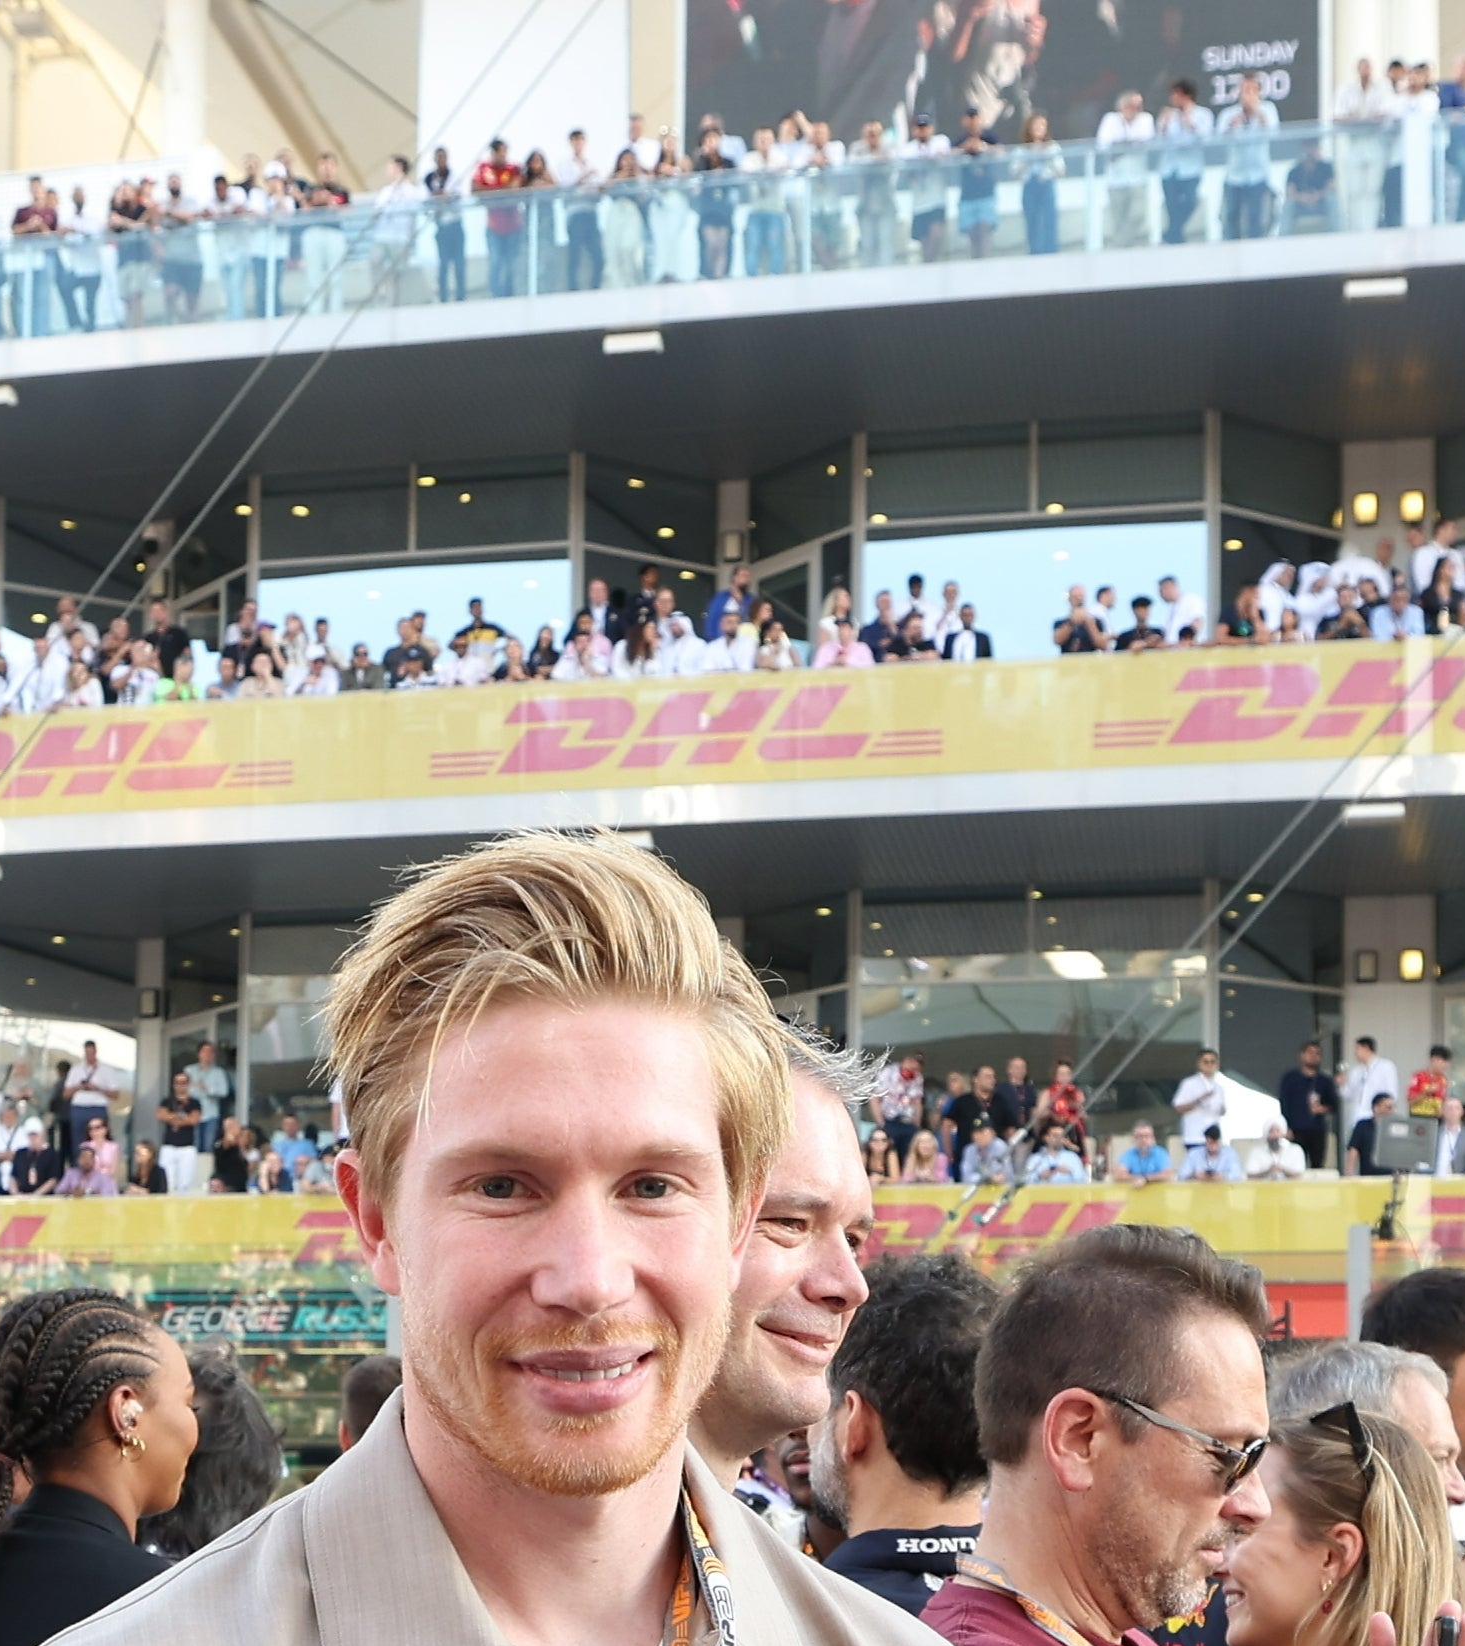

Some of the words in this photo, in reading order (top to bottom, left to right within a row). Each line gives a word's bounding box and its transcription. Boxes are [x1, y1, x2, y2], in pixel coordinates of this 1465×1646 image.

[1201, 39, 1299, 71] SUNDAY
[497, 684, 874, 775] DHL
[161, 1304, 291, 1333] GEORGE
[896, 1537, 980, 1554] HOND
